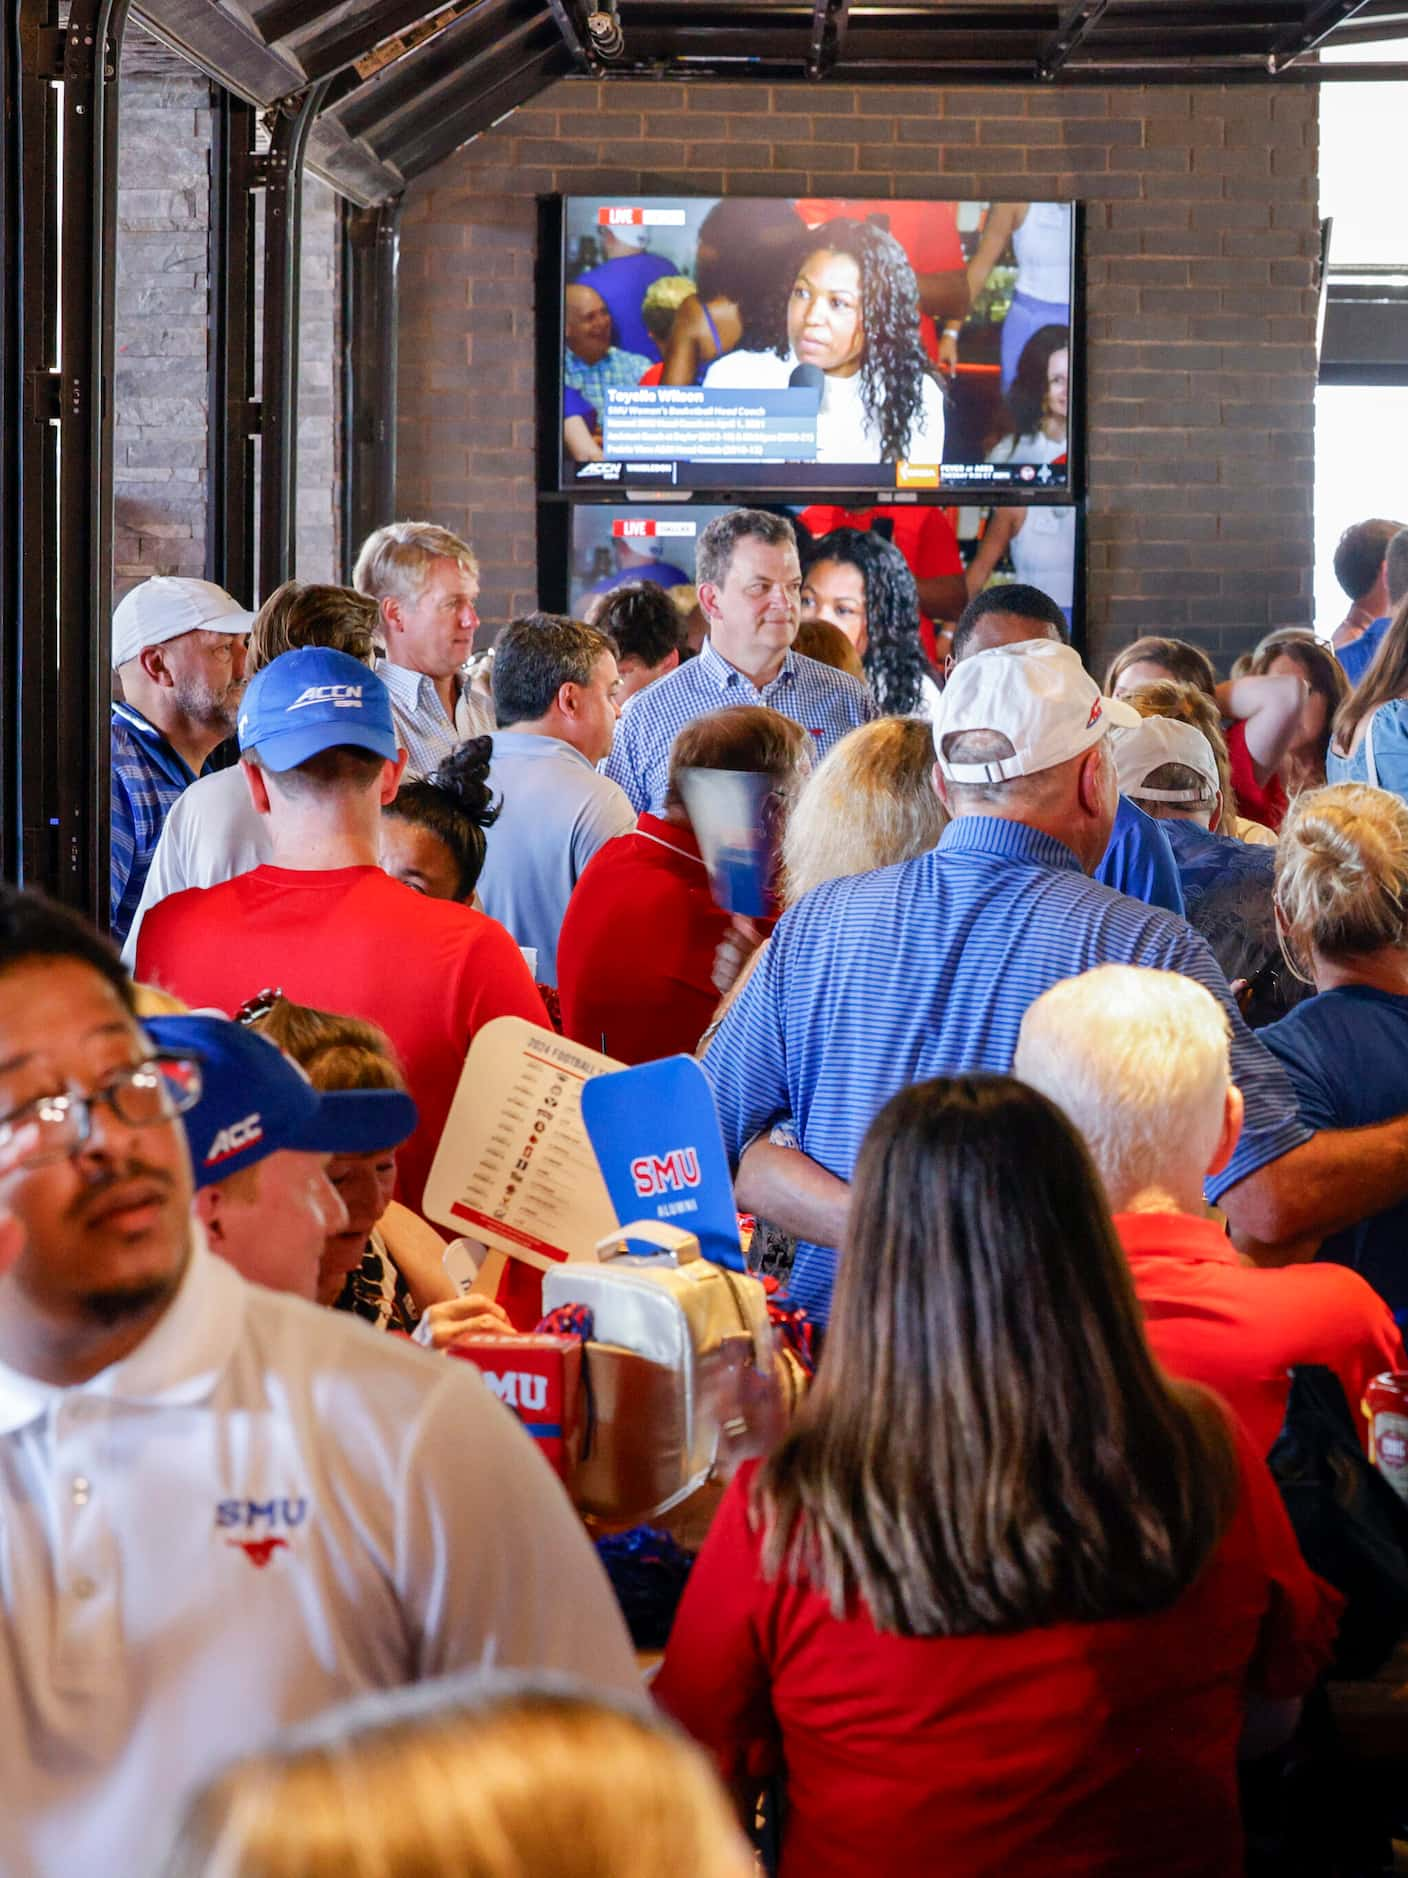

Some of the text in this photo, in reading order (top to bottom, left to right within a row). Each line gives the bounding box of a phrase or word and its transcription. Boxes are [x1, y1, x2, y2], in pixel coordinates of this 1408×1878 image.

[609, 208, 633, 225] LIVE
[658, 388, 705, 403] Wilson
[579, 463, 622, 475] ACCN
[623, 520, 647, 537] LIVE
[290, 684, 363, 707] ACCN
[551, 1047, 595, 1075] FOOTBALL
[207, 1112, 262, 1162] ACC
[630, 1146, 702, 1198] SMU
[481, 1370, 549, 1411] MU
[214, 1498, 307, 1529] SMU
